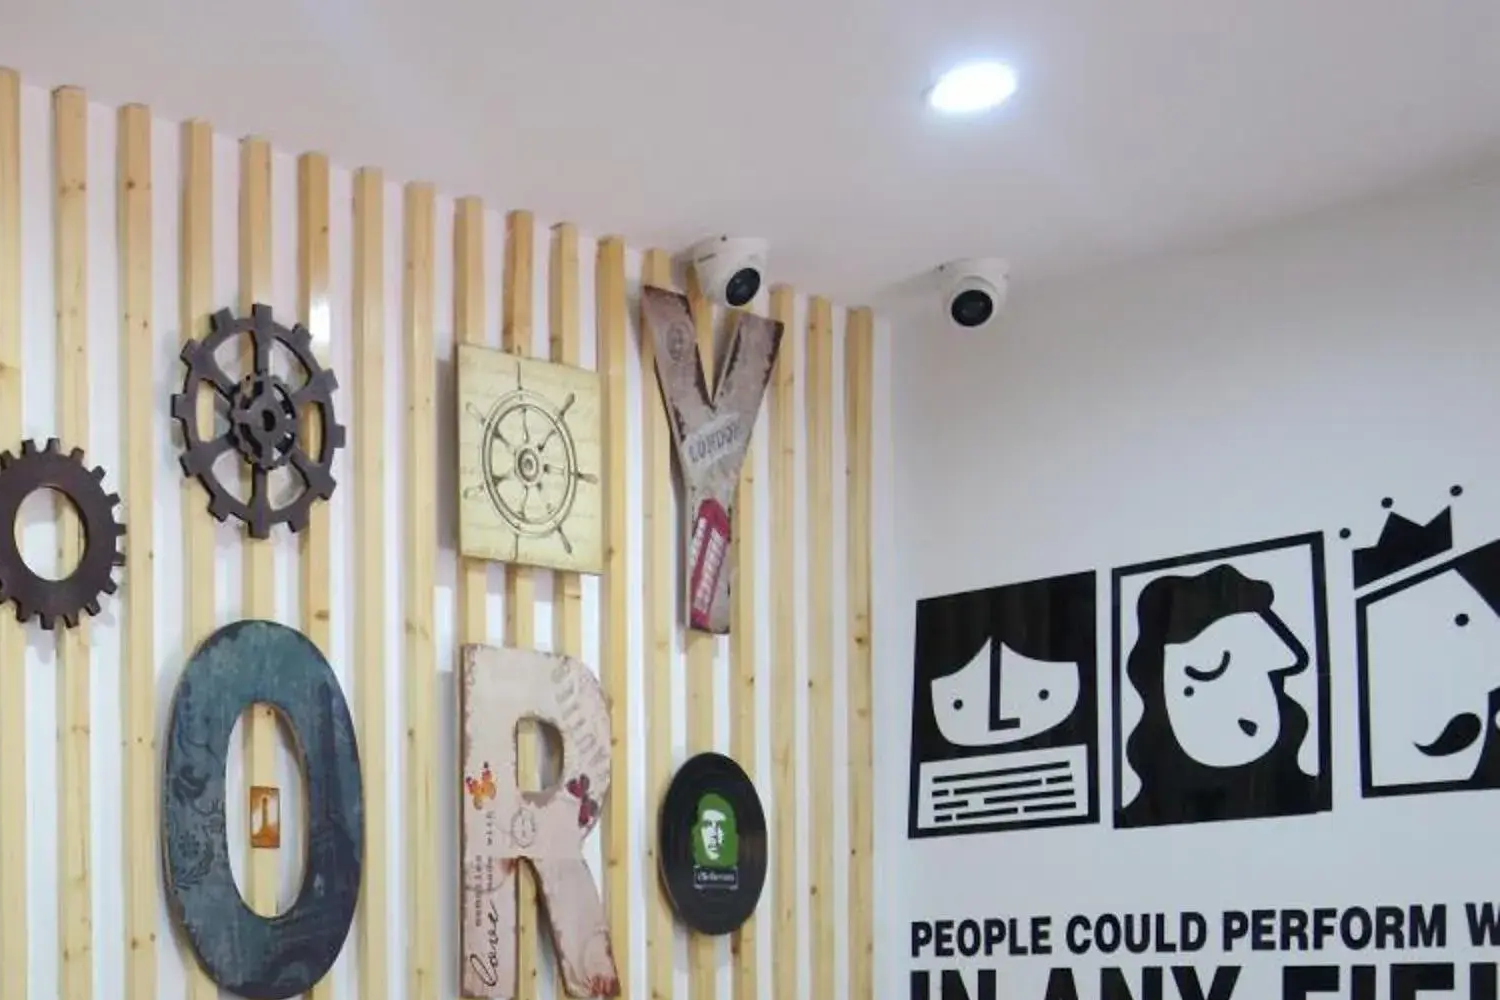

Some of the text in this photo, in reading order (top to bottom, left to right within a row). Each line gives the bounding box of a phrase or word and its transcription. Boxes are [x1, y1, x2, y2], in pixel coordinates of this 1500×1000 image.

[688, 420, 743, 463] LONDON
[911, 917, 1052, 957] PEOPLE
[1065, 911, 1207, 954] COULD
[1223, 904, 1447, 951] PERFORM
